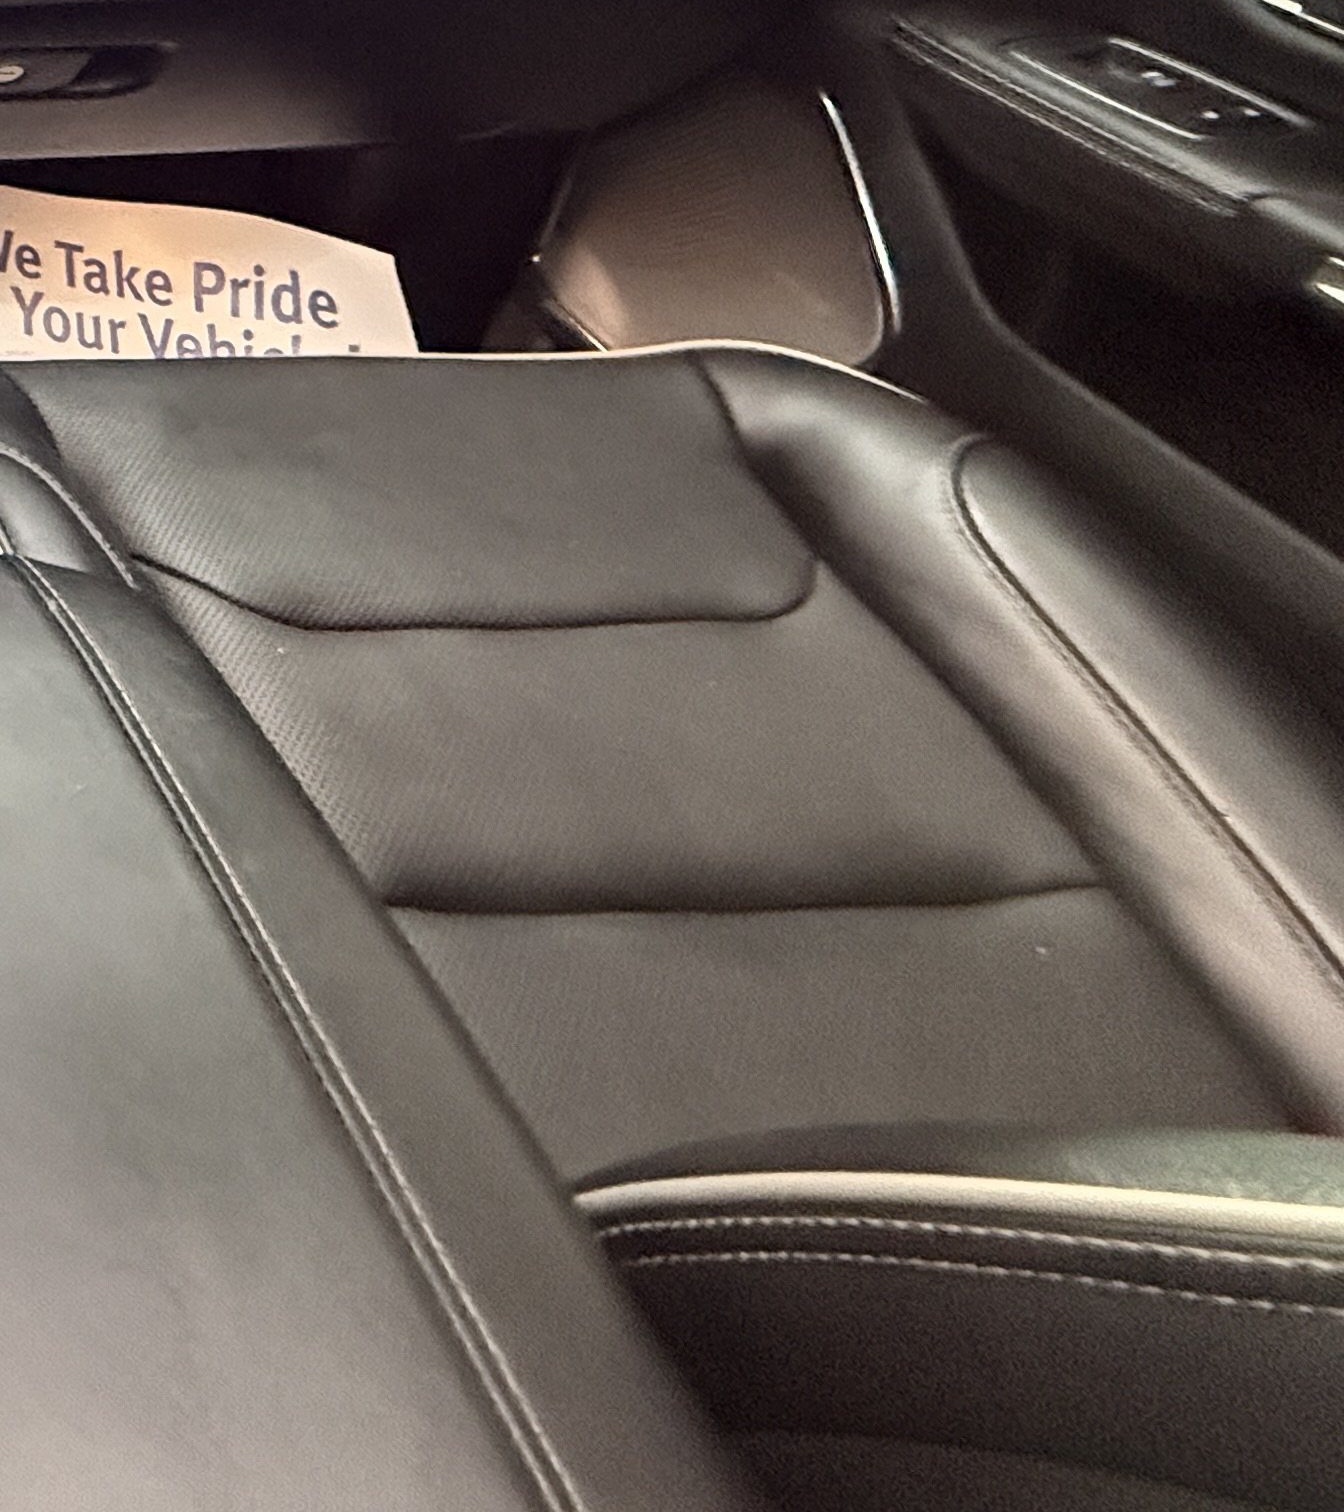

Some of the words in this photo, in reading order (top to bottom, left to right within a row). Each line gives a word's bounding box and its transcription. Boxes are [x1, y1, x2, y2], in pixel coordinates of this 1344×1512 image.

[9, 284, 127, 356] Your
[54, 237, 174, 308] Take
[192, 261, 340, 330] Pride
